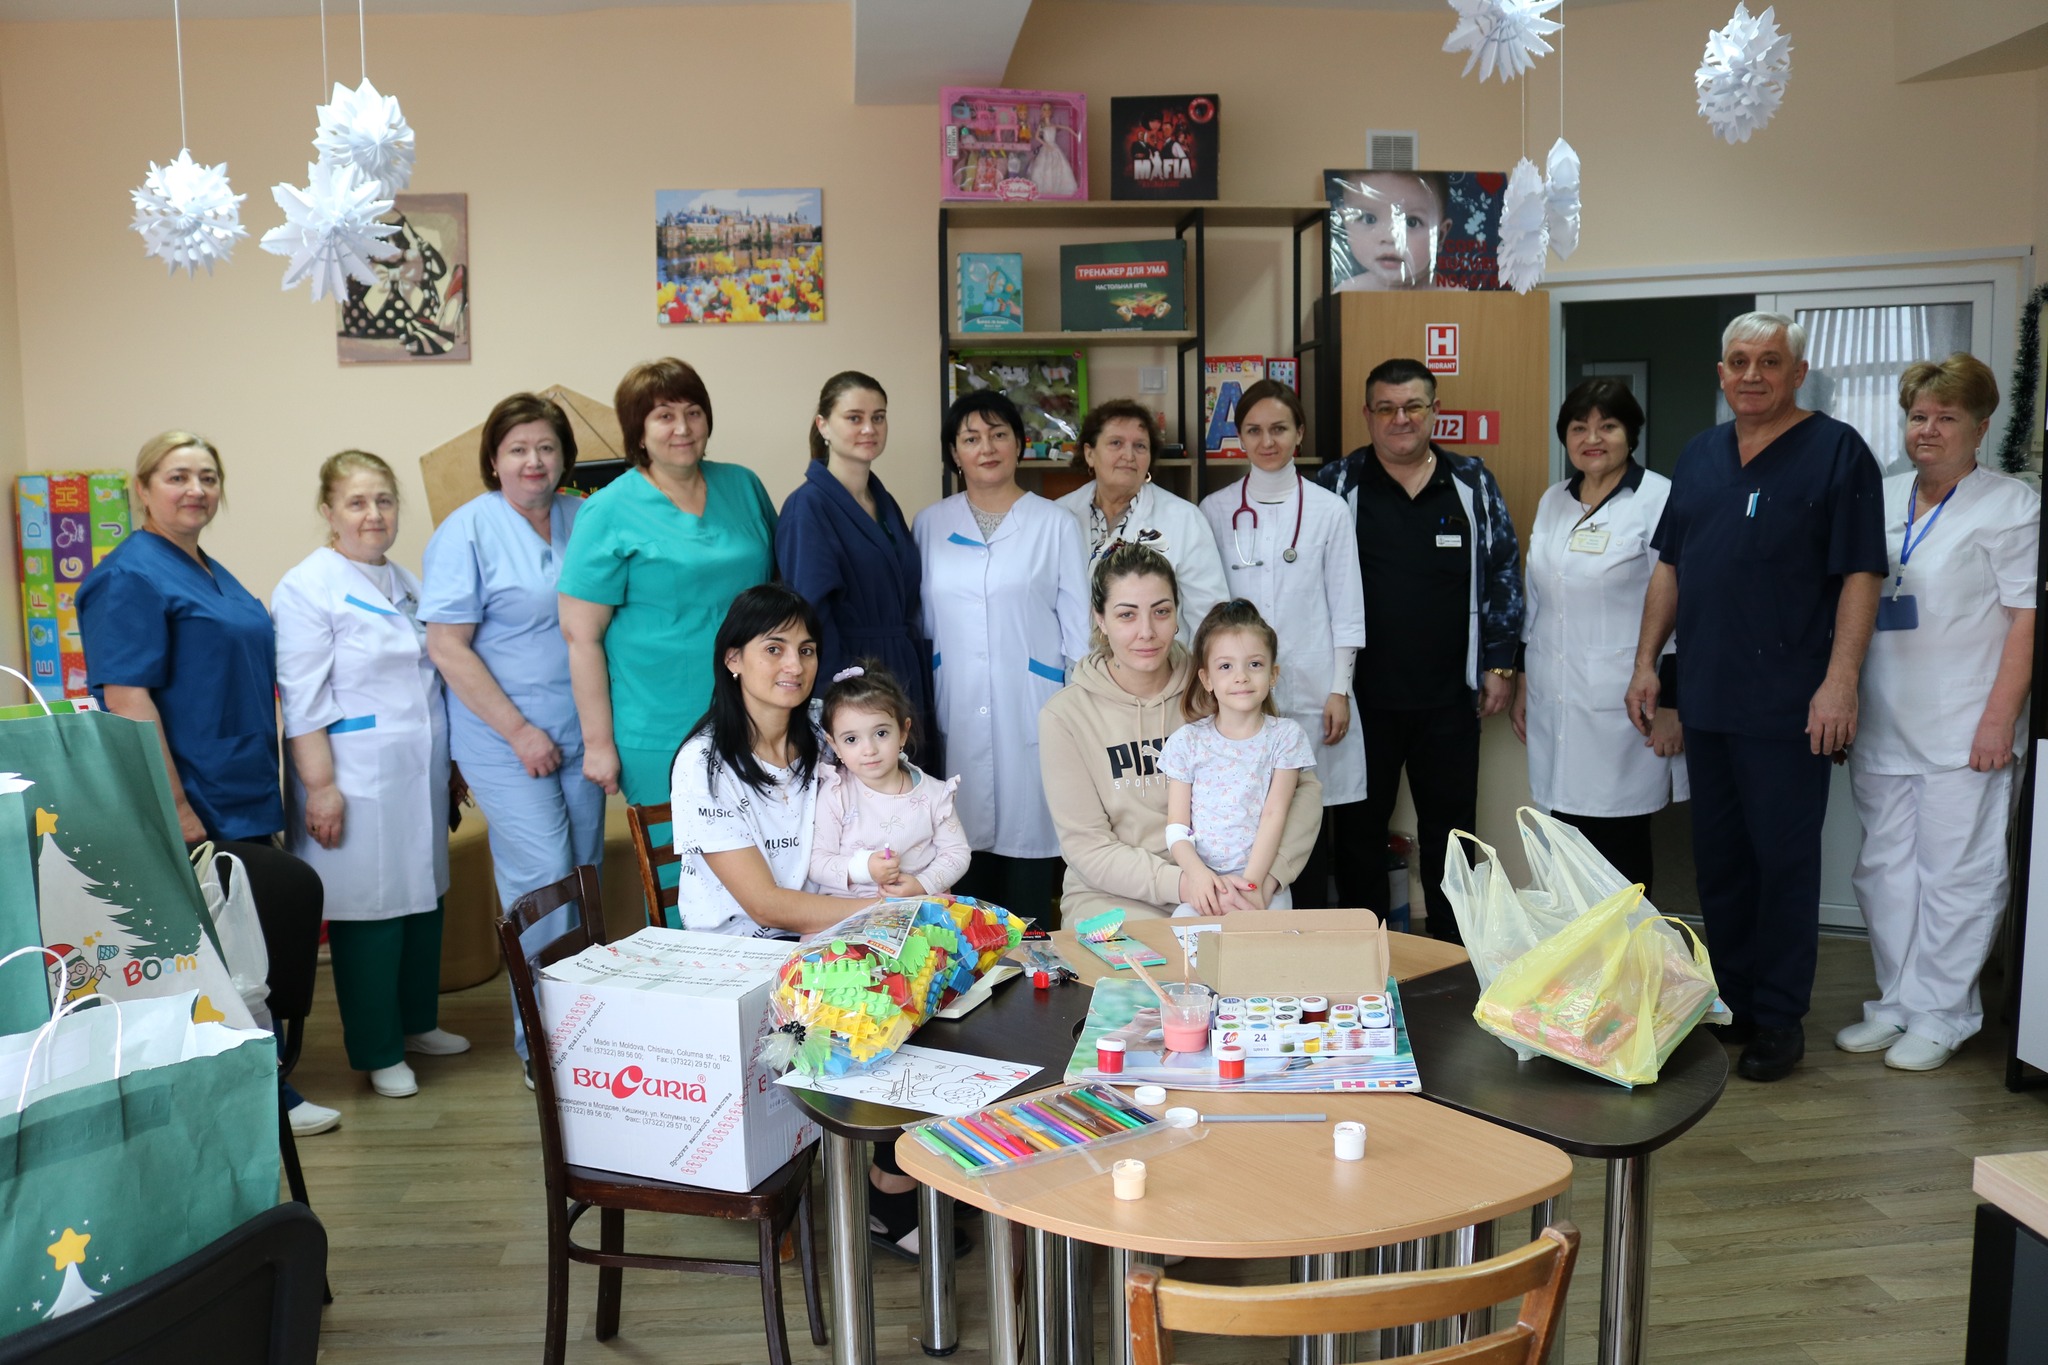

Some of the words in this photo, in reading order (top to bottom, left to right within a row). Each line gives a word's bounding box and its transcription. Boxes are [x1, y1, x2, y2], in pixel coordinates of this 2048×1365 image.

[1079, 267, 1125, 277] ТРЕНАЖЕР
[1126, 266, 1144, 277] ДЛЯ
[1146, 265, 1167, 274] УМА
[1430, 328, 1454, 355] H
[1433, 419, 1460, 437] 112
[698, 807, 735, 818] MUSIC
[1254, 1033, 1267, 1043] 24
[593, 1038, 610, 1047] Made
[612, 1040, 618, 1048] in
[676, 1048, 704, 1059] Columna
[594, 1047, 616, 1058] (37322)
[617, 1050, 625, 1058] 89
[670, 1057, 694, 1068] (37322)
[695, 1060, 703, 1068] 29
[703, 1061, 712, 1069] 57
[712, 1062, 721, 1070] 00
